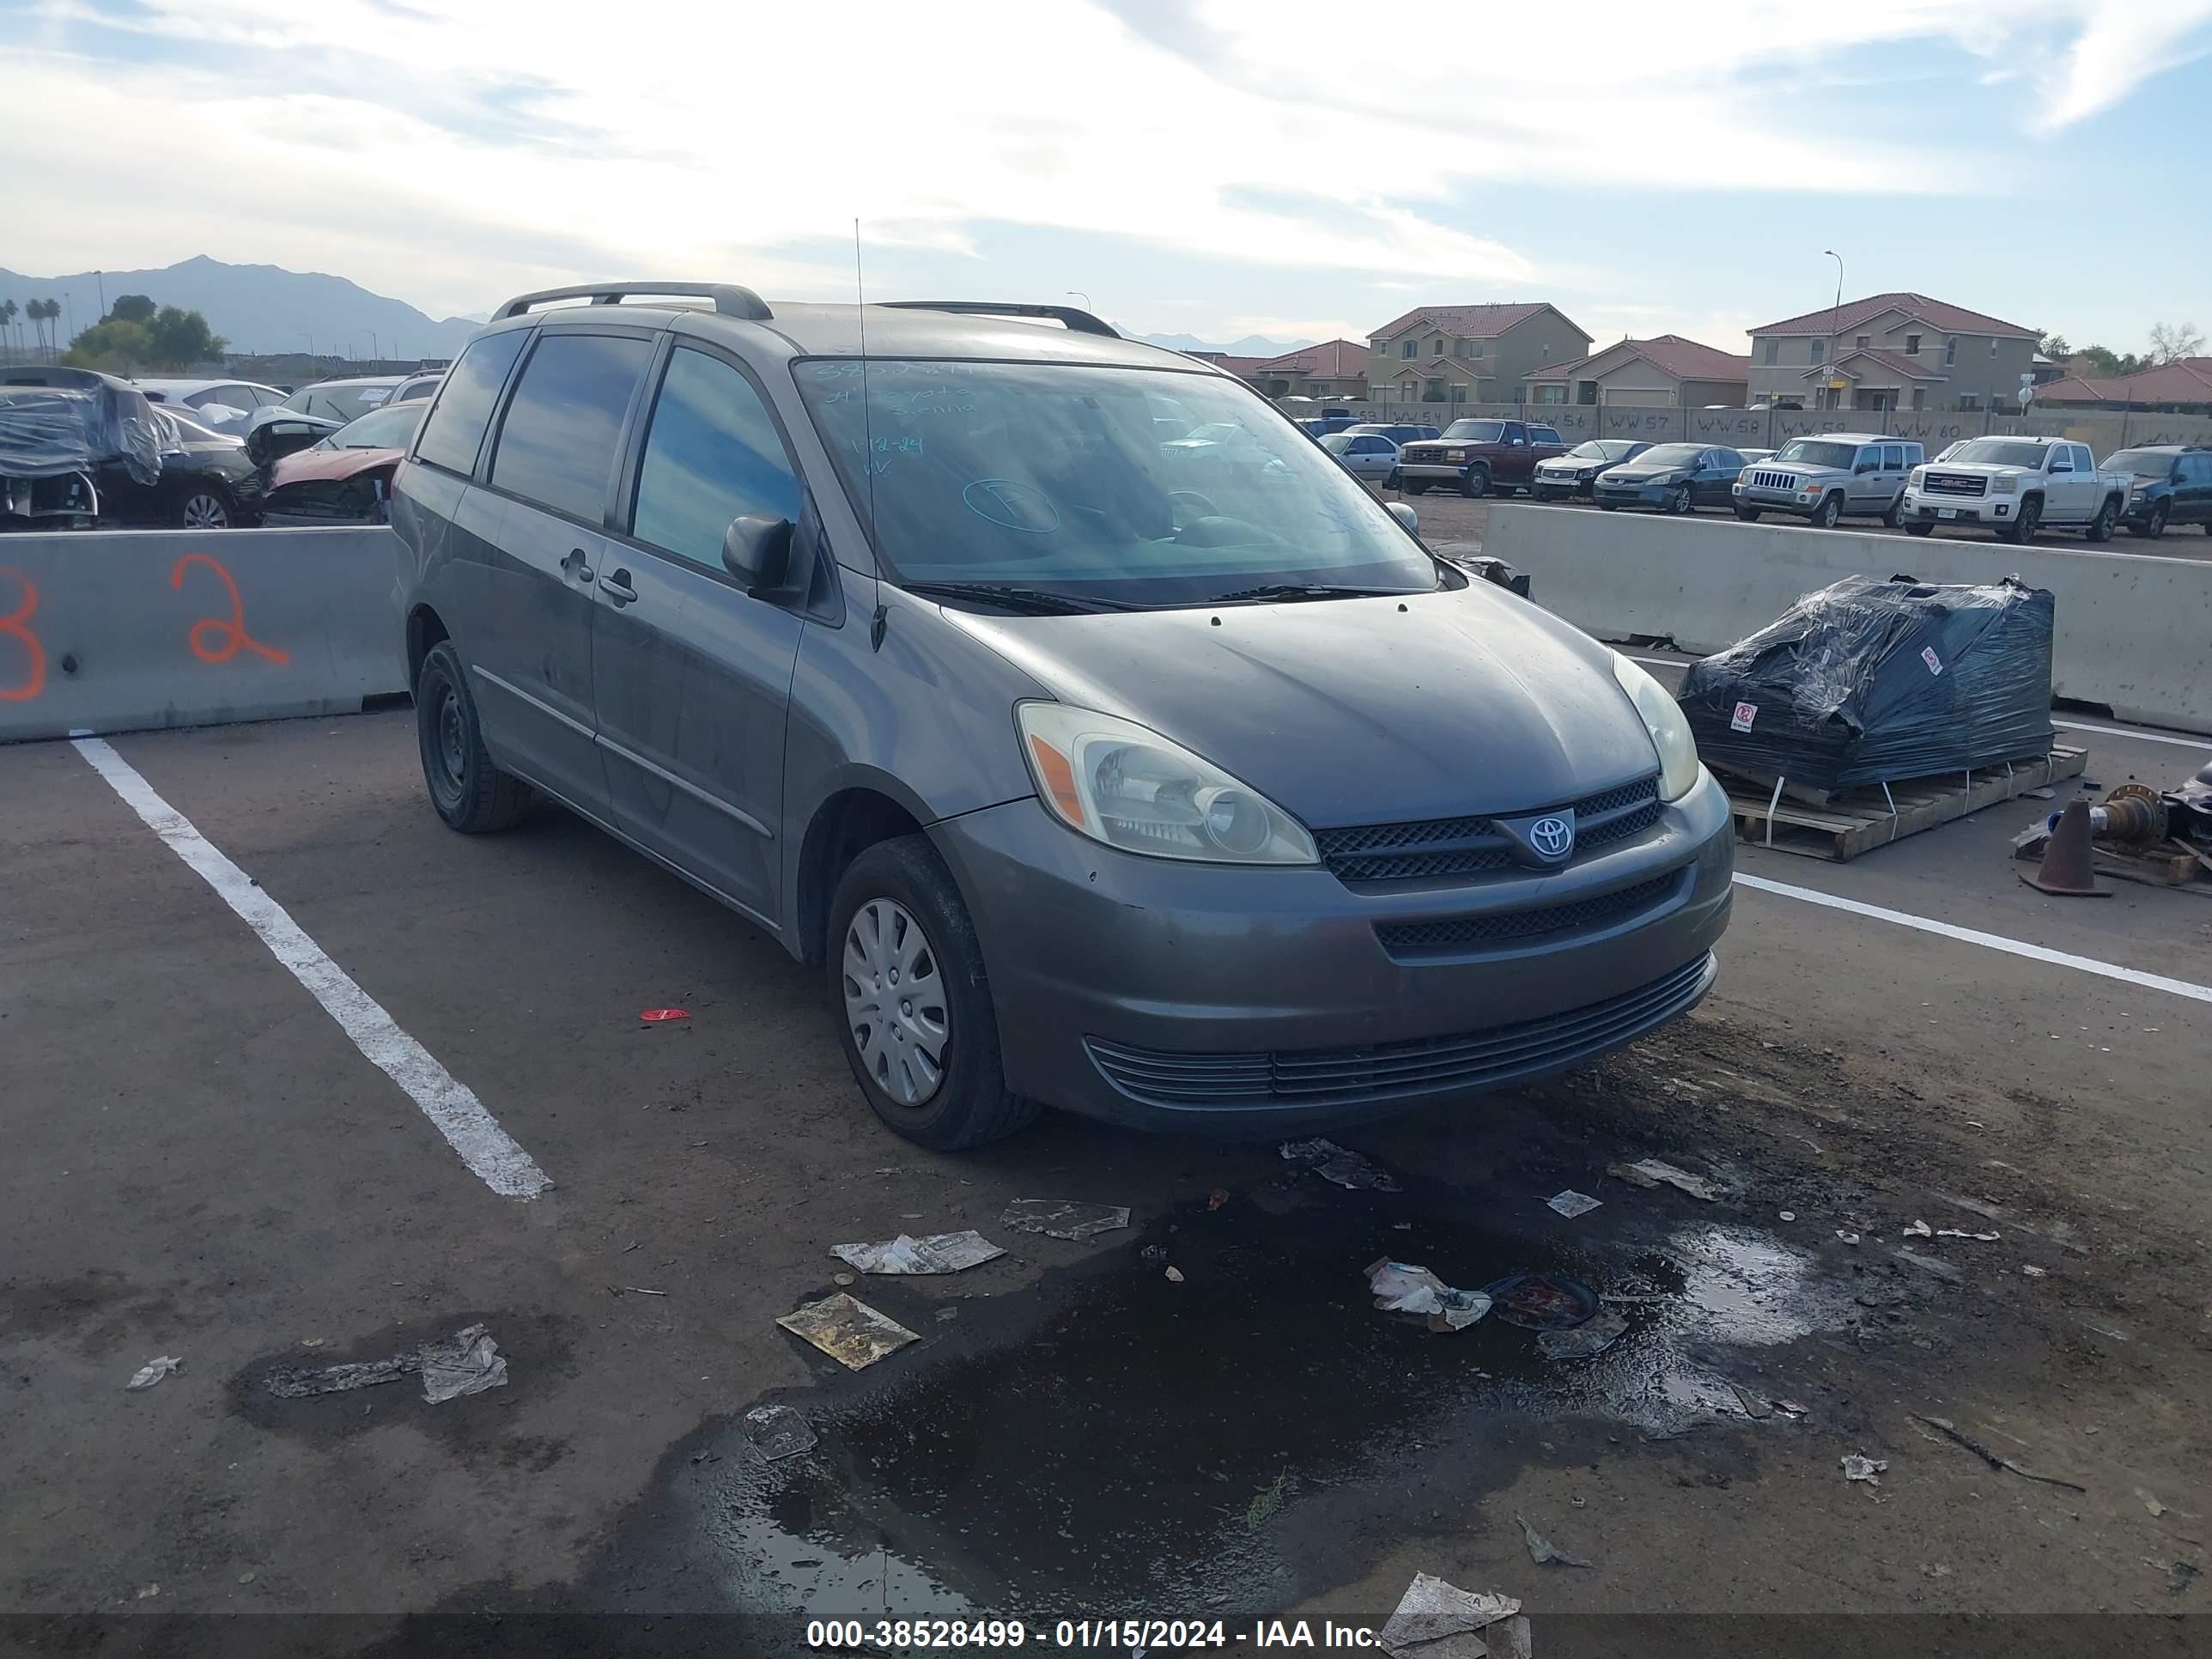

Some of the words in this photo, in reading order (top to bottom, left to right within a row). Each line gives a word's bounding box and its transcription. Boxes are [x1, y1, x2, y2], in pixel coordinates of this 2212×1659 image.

[1395, 411, 1418, 422] WW
[1423, 411, 1442, 422] 54
[1530, 414, 1559, 427] WW
[1564, 416, 1586, 428] 56
[1610, 416, 1640, 429] WW
[1646, 416, 1668, 429] 57
[1698, 418, 1730, 433] WW
[1738, 420, 1759, 434] 58
[1781, 422, 1814, 434] WW
[1895, 423, 1931, 437] WW
[1940, 424, 1960, 438] 60
[1941, 478, 1967, 488] GMC
